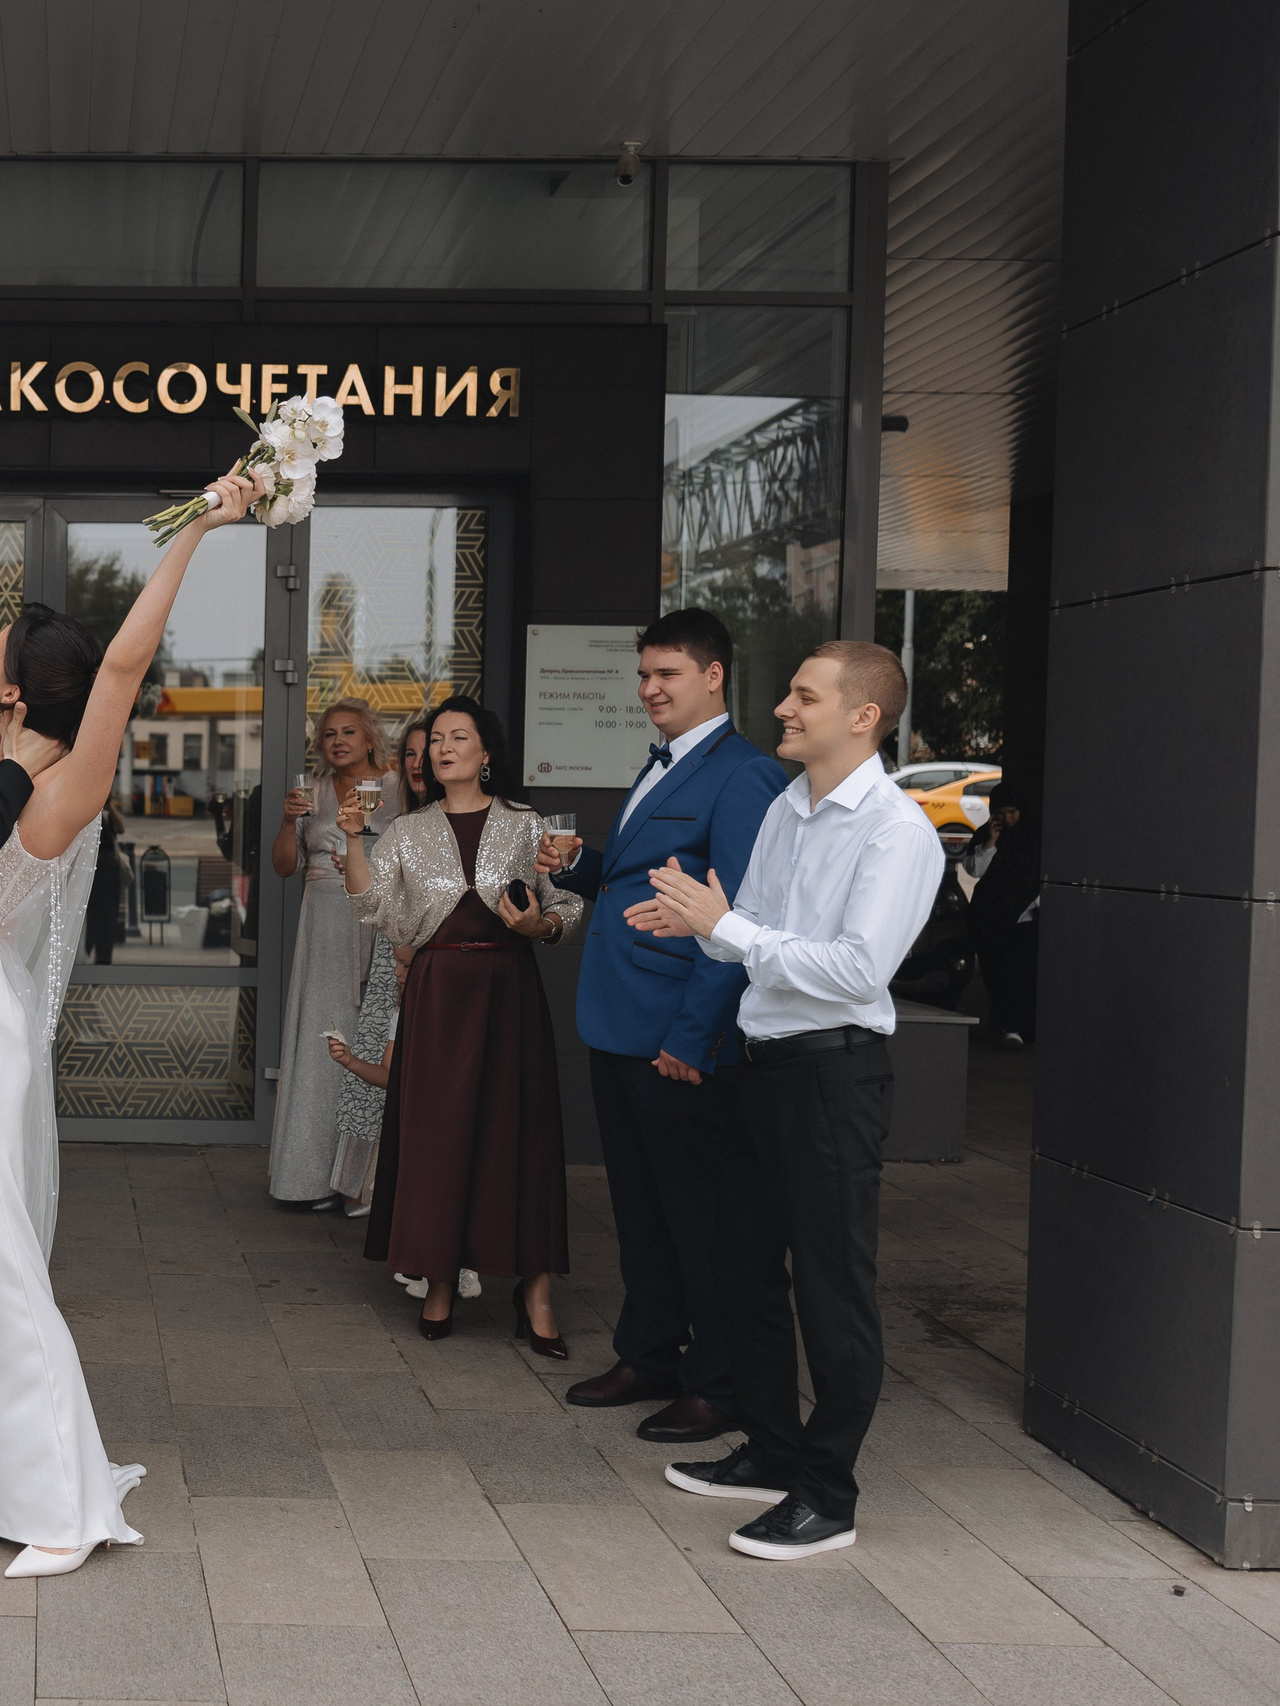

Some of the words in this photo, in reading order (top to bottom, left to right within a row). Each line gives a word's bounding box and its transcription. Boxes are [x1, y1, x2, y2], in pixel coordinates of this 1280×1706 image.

[539, 692, 570, 700] РЕЖИМ
[572, 692, 606, 700] РАБОТЫ
[598, 705, 618, 714] 9:00
[594, 720, 618, 729] 10:00
[625, 720, 647, 729] 19:00
